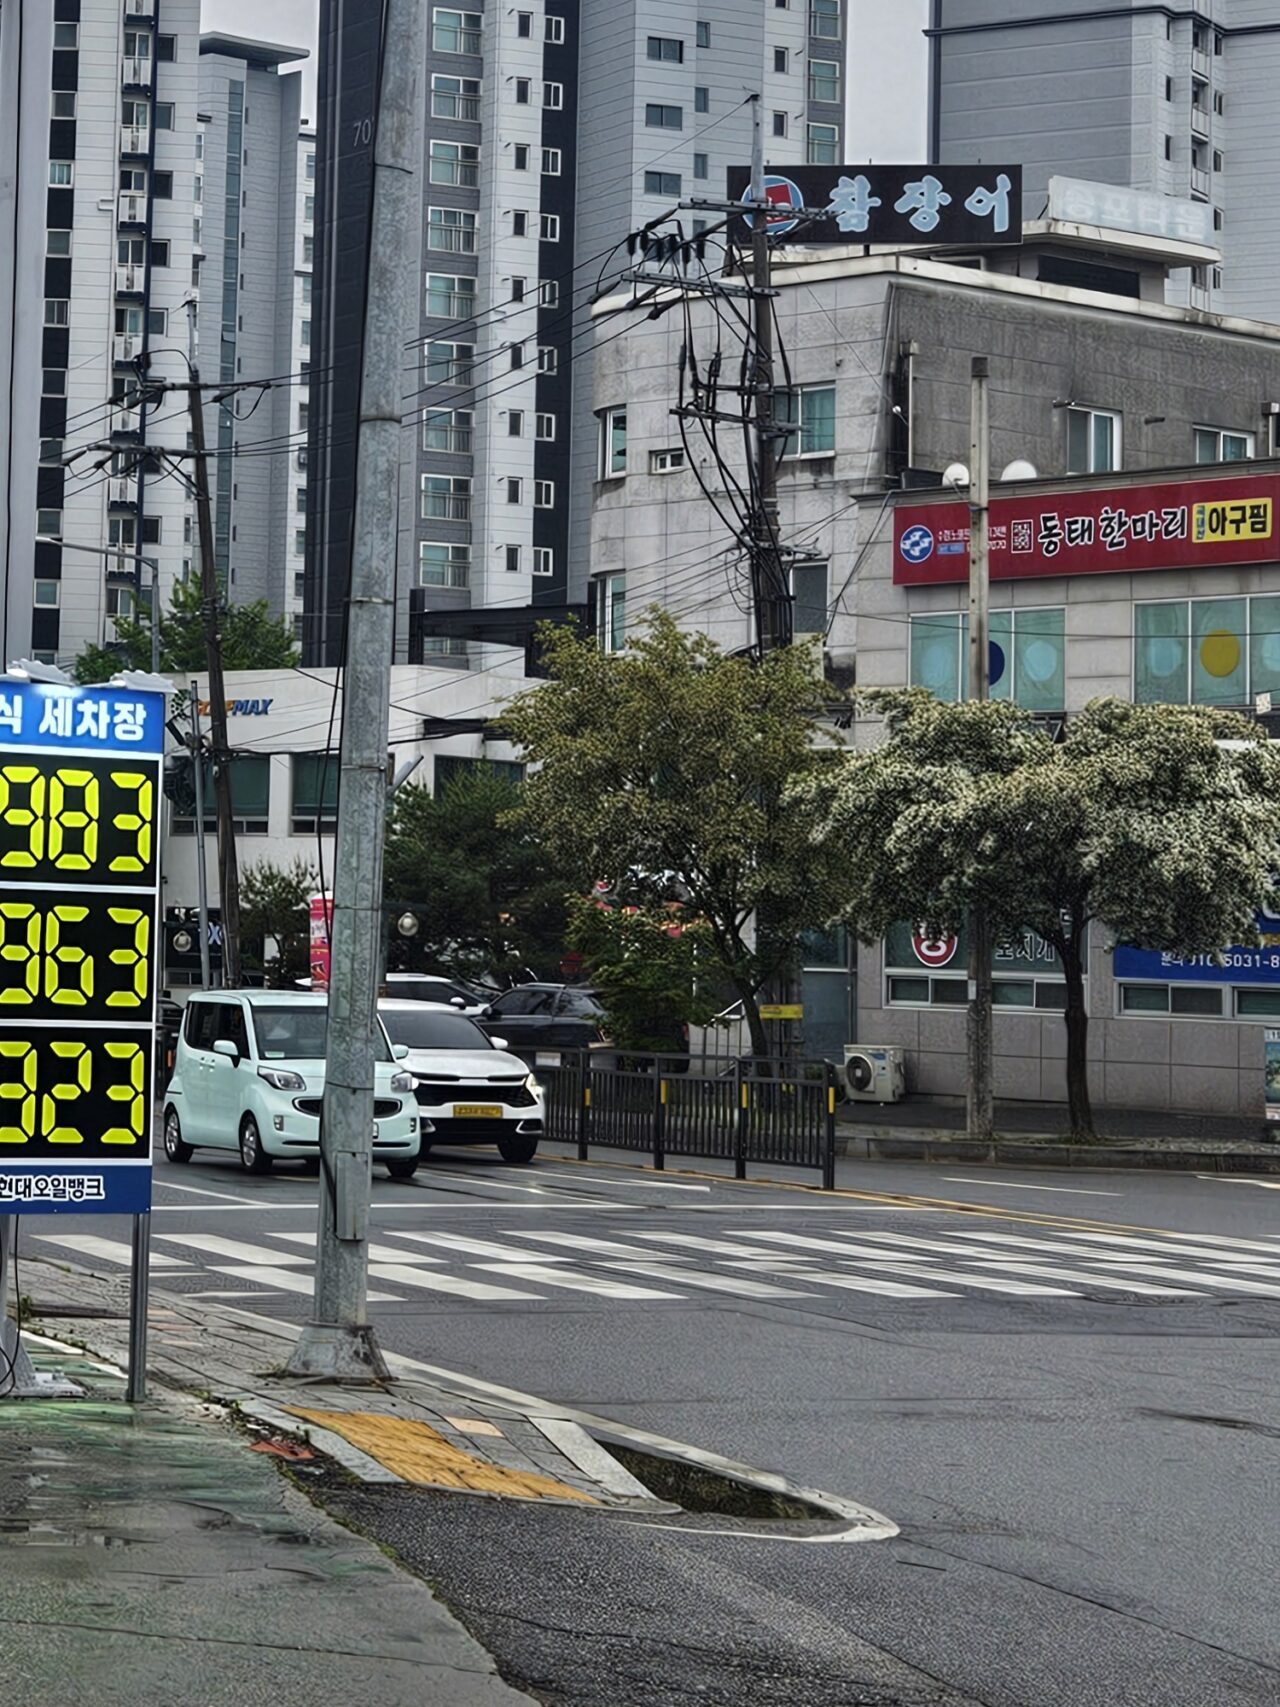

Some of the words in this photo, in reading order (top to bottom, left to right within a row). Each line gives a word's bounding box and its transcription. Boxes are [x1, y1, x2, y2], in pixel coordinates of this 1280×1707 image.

[353, 117, 375, 147] 70
[1038, 512, 1094, 557] 동태
[1099, 506, 1187, 550] 한마리
[39, 697, 146, 741] 세차장
